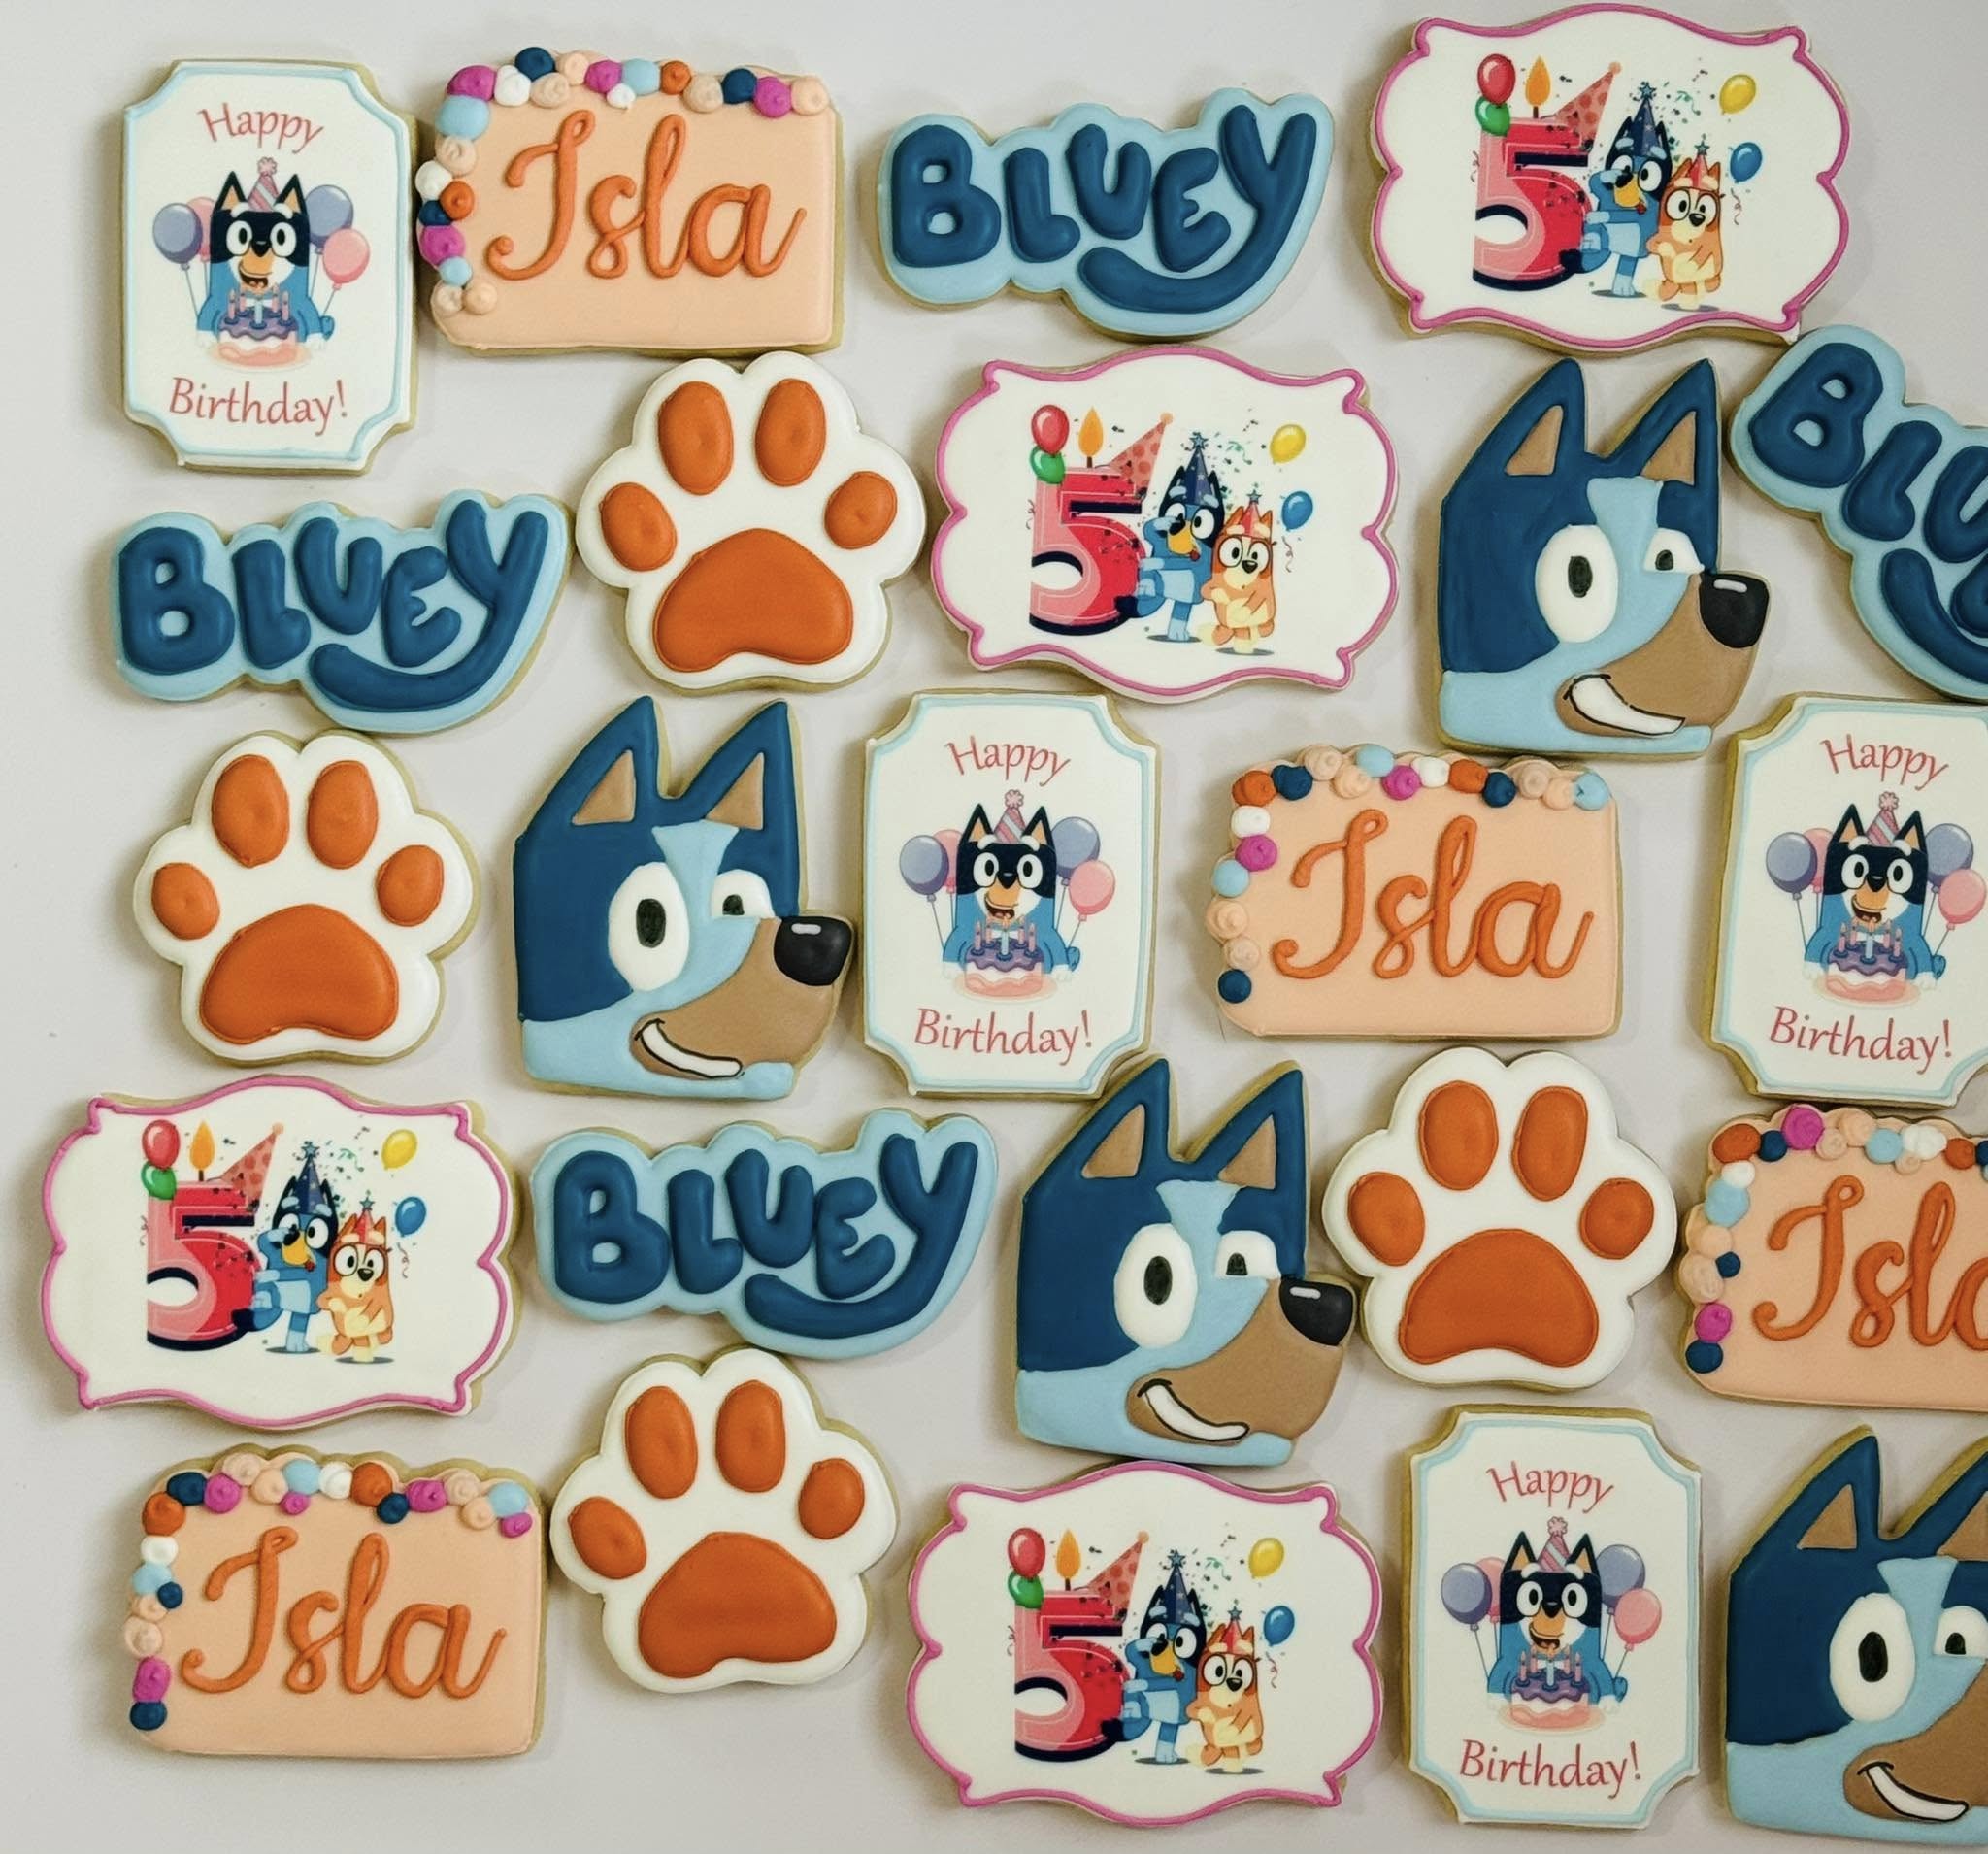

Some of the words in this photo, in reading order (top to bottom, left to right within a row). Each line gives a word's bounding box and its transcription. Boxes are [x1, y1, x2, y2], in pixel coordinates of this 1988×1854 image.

[198, 103, 324, 153] Happy
[487, 110, 807, 281] Isla
[892, 104, 1317, 315] BLUEY
[1473, 116, 1592, 291] 5
[169, 377, 348, 436] Birthday!
[1029, 466, 1146, 636] 5
[1748, 342, 1988, 685] BLU
[118, 499, 549, 713] BLUEY
[944, 735, 1071, 786] Happy
[1819, 734, 1949, 791] Happy
[1272, 809, 1594, 979] Isla
[914, 1008, 1092, 1066] Birthday!
[1770, 1006, 1952, 1075] Birthday!
[147, 1181, 262, 1351] 5
[554, 1133, 979, 1340] BLUEY
[1486, 1461, 1614, 1513] Happy
[181, 1526, 507, 1699] Isla
[1014, 1590, 1130, 1762] 5
[1459, 1739, 1641, 1799] Birthday!
